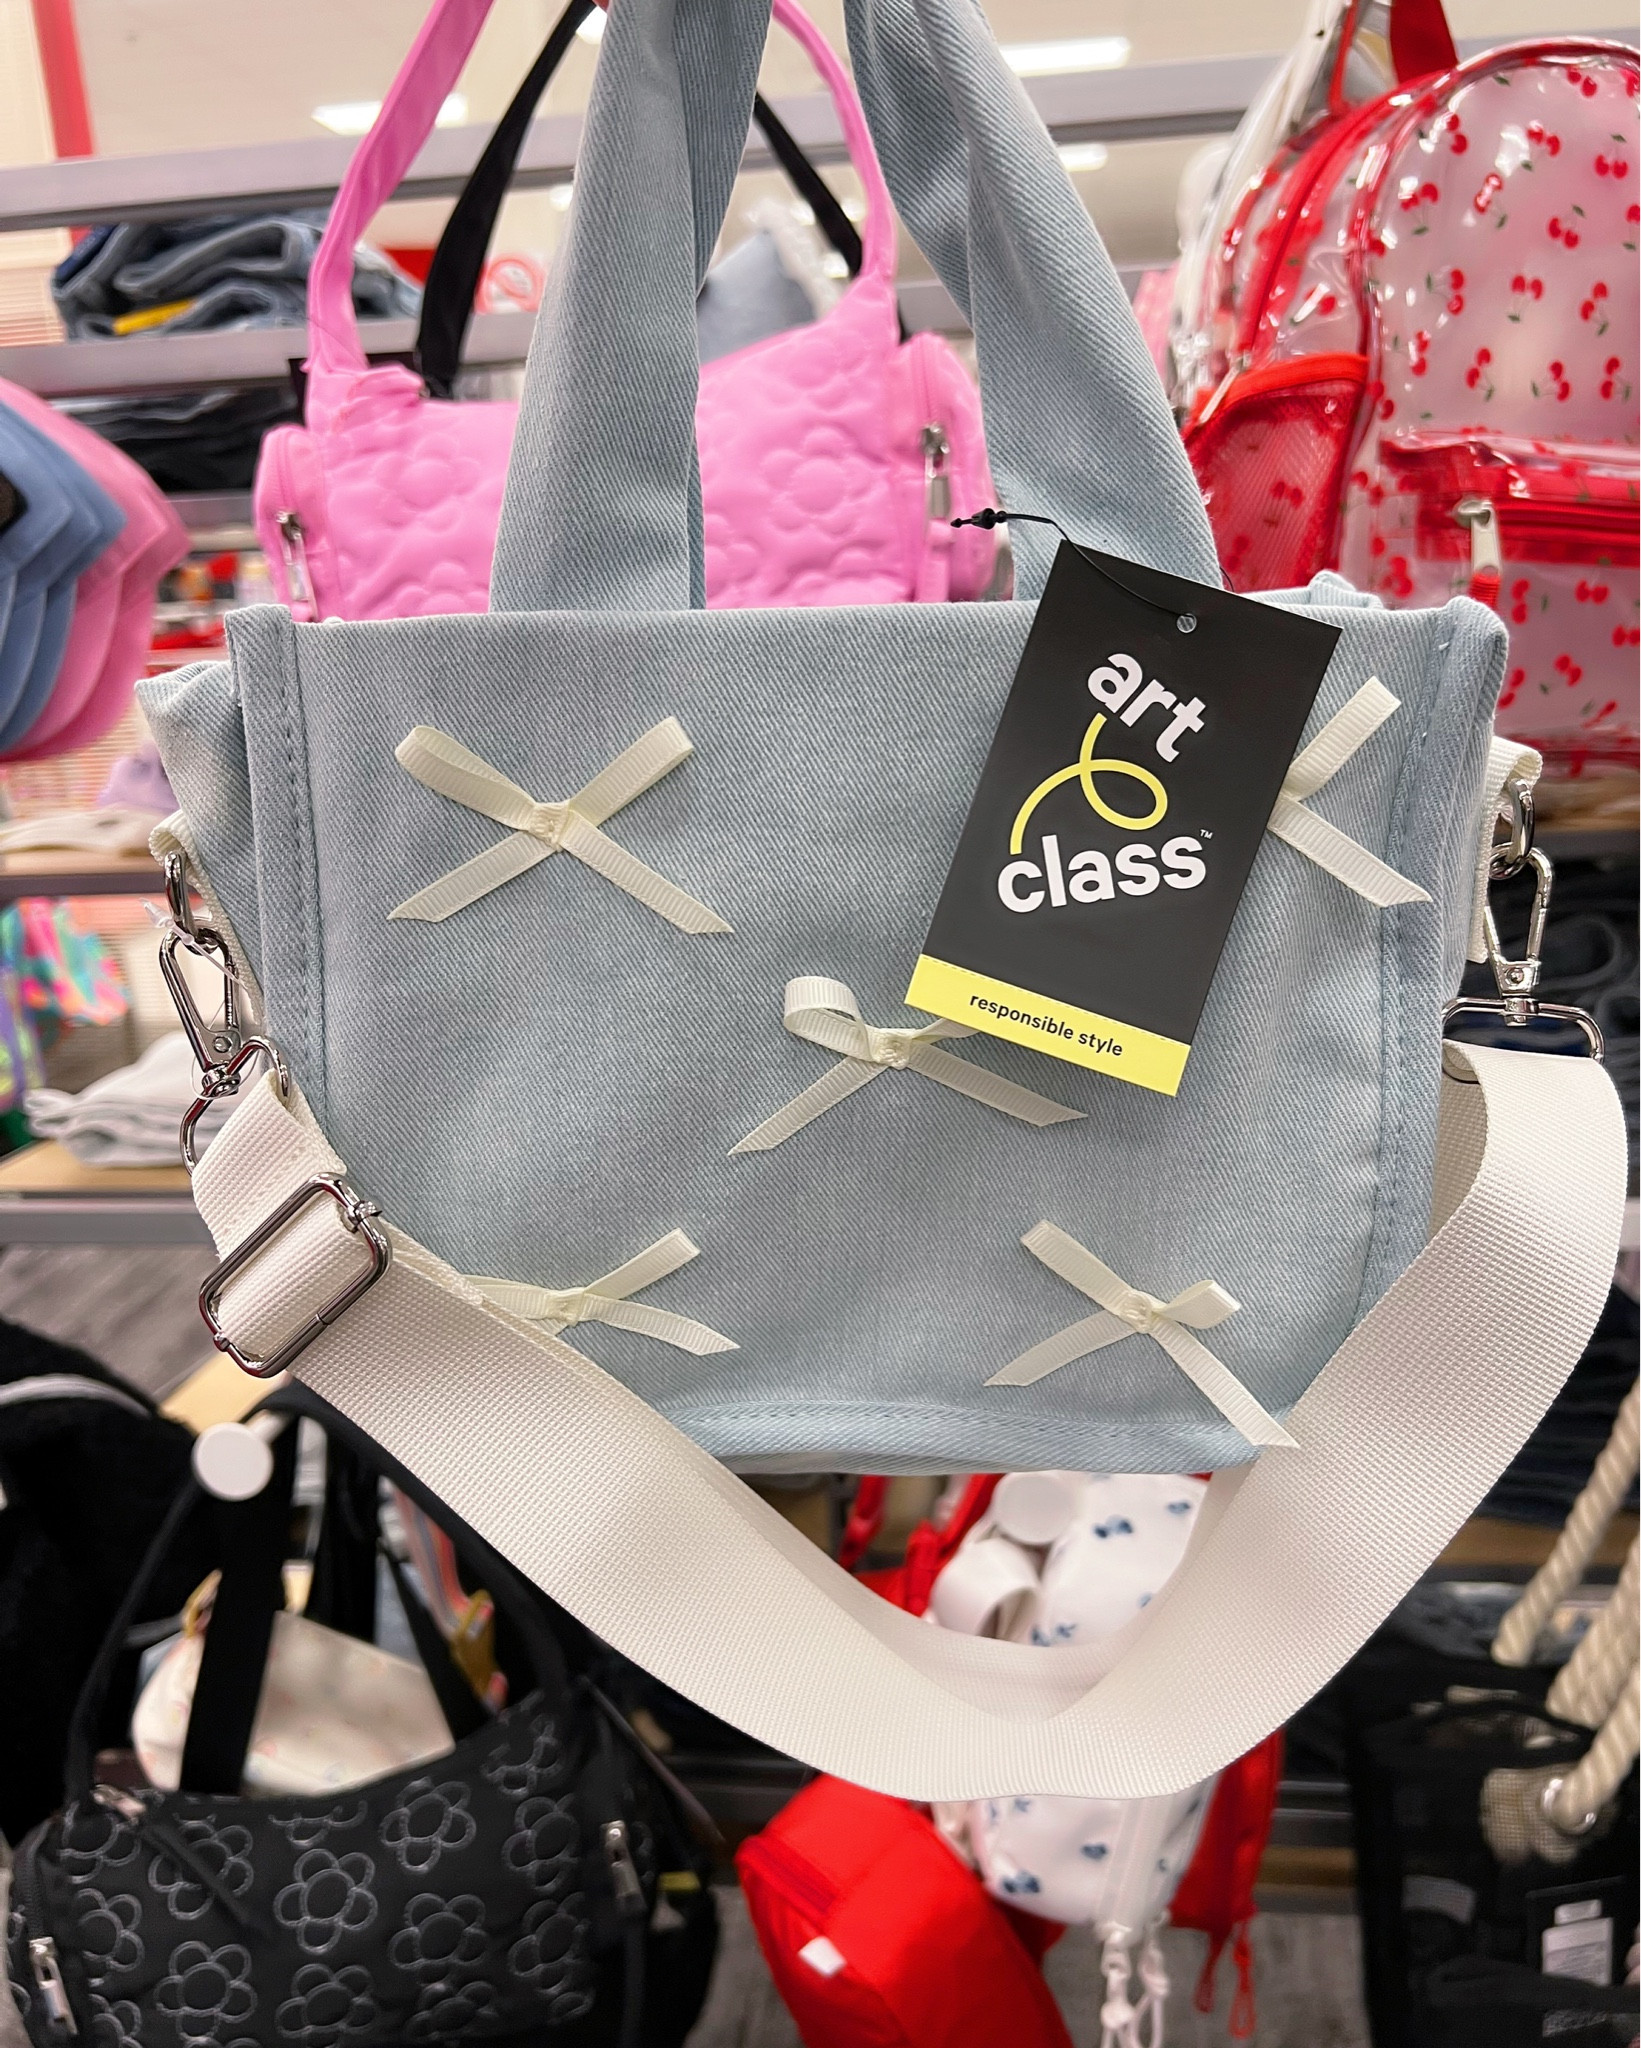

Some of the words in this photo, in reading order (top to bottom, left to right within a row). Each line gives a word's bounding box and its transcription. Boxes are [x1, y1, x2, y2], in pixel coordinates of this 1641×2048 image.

[1087, 653, 1205, 763] art
[997, 834, 1207, 913] class
[969, 994, 1074, 1040] responsible
[1078, 1032, 1123, 1056] style
